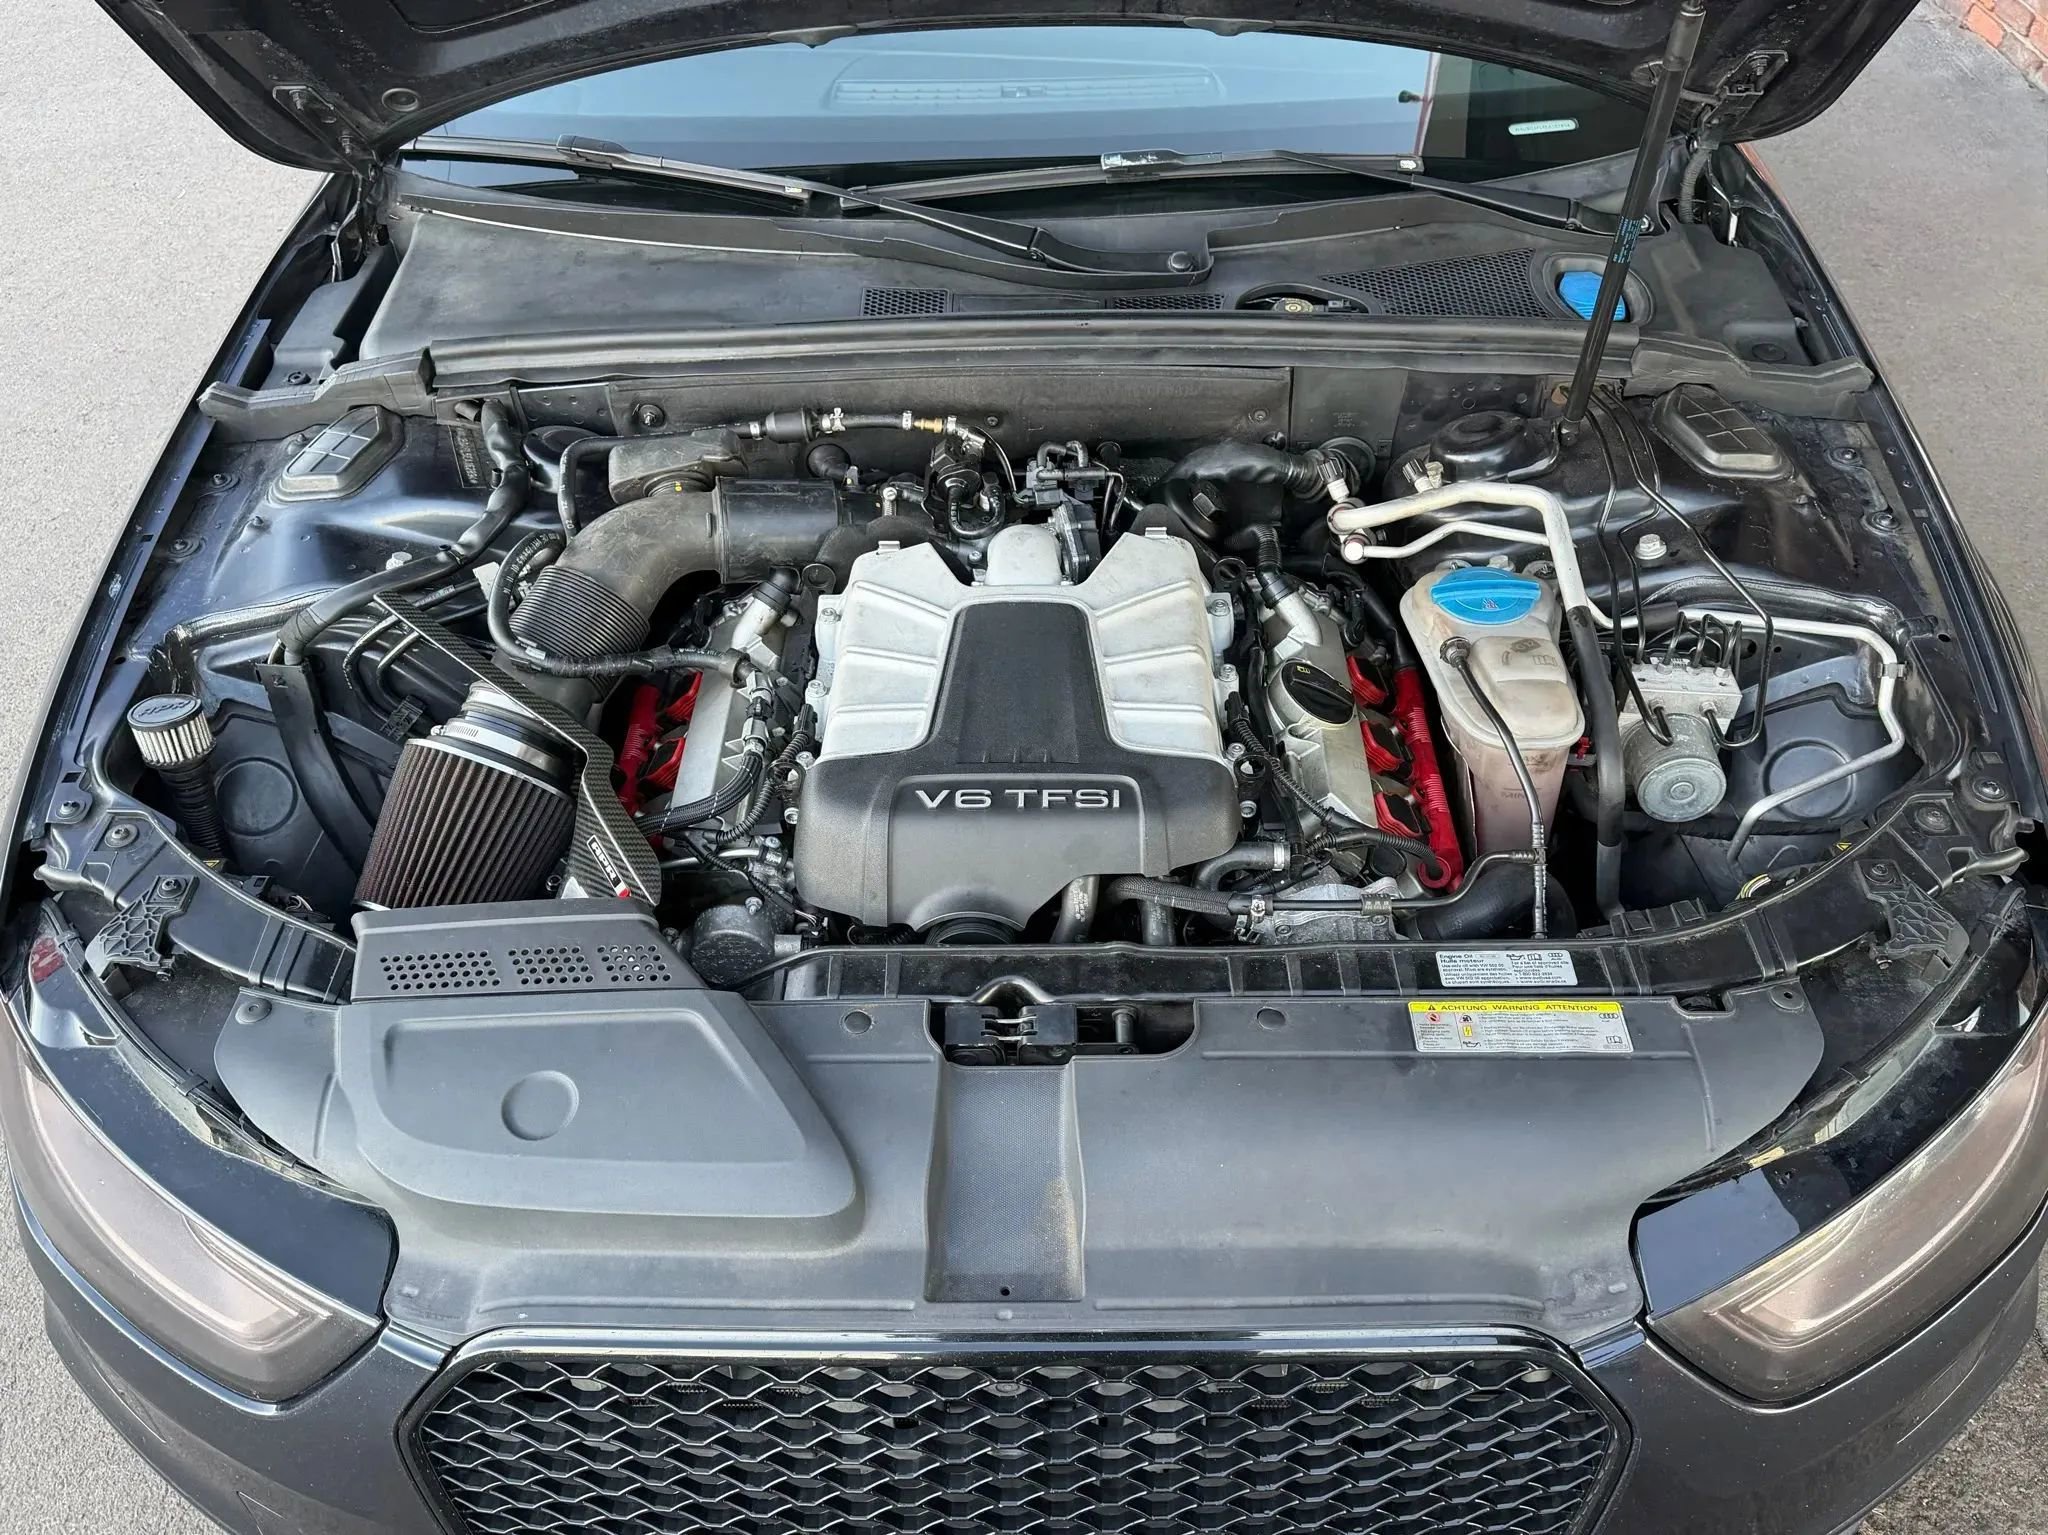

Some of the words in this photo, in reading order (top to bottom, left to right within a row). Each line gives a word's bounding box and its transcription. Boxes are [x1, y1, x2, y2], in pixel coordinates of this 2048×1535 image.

[915, 788, 992, 809] V6
[1004, 788, 1120, 809] TFSI
[589, 840, 618, 881] APR
